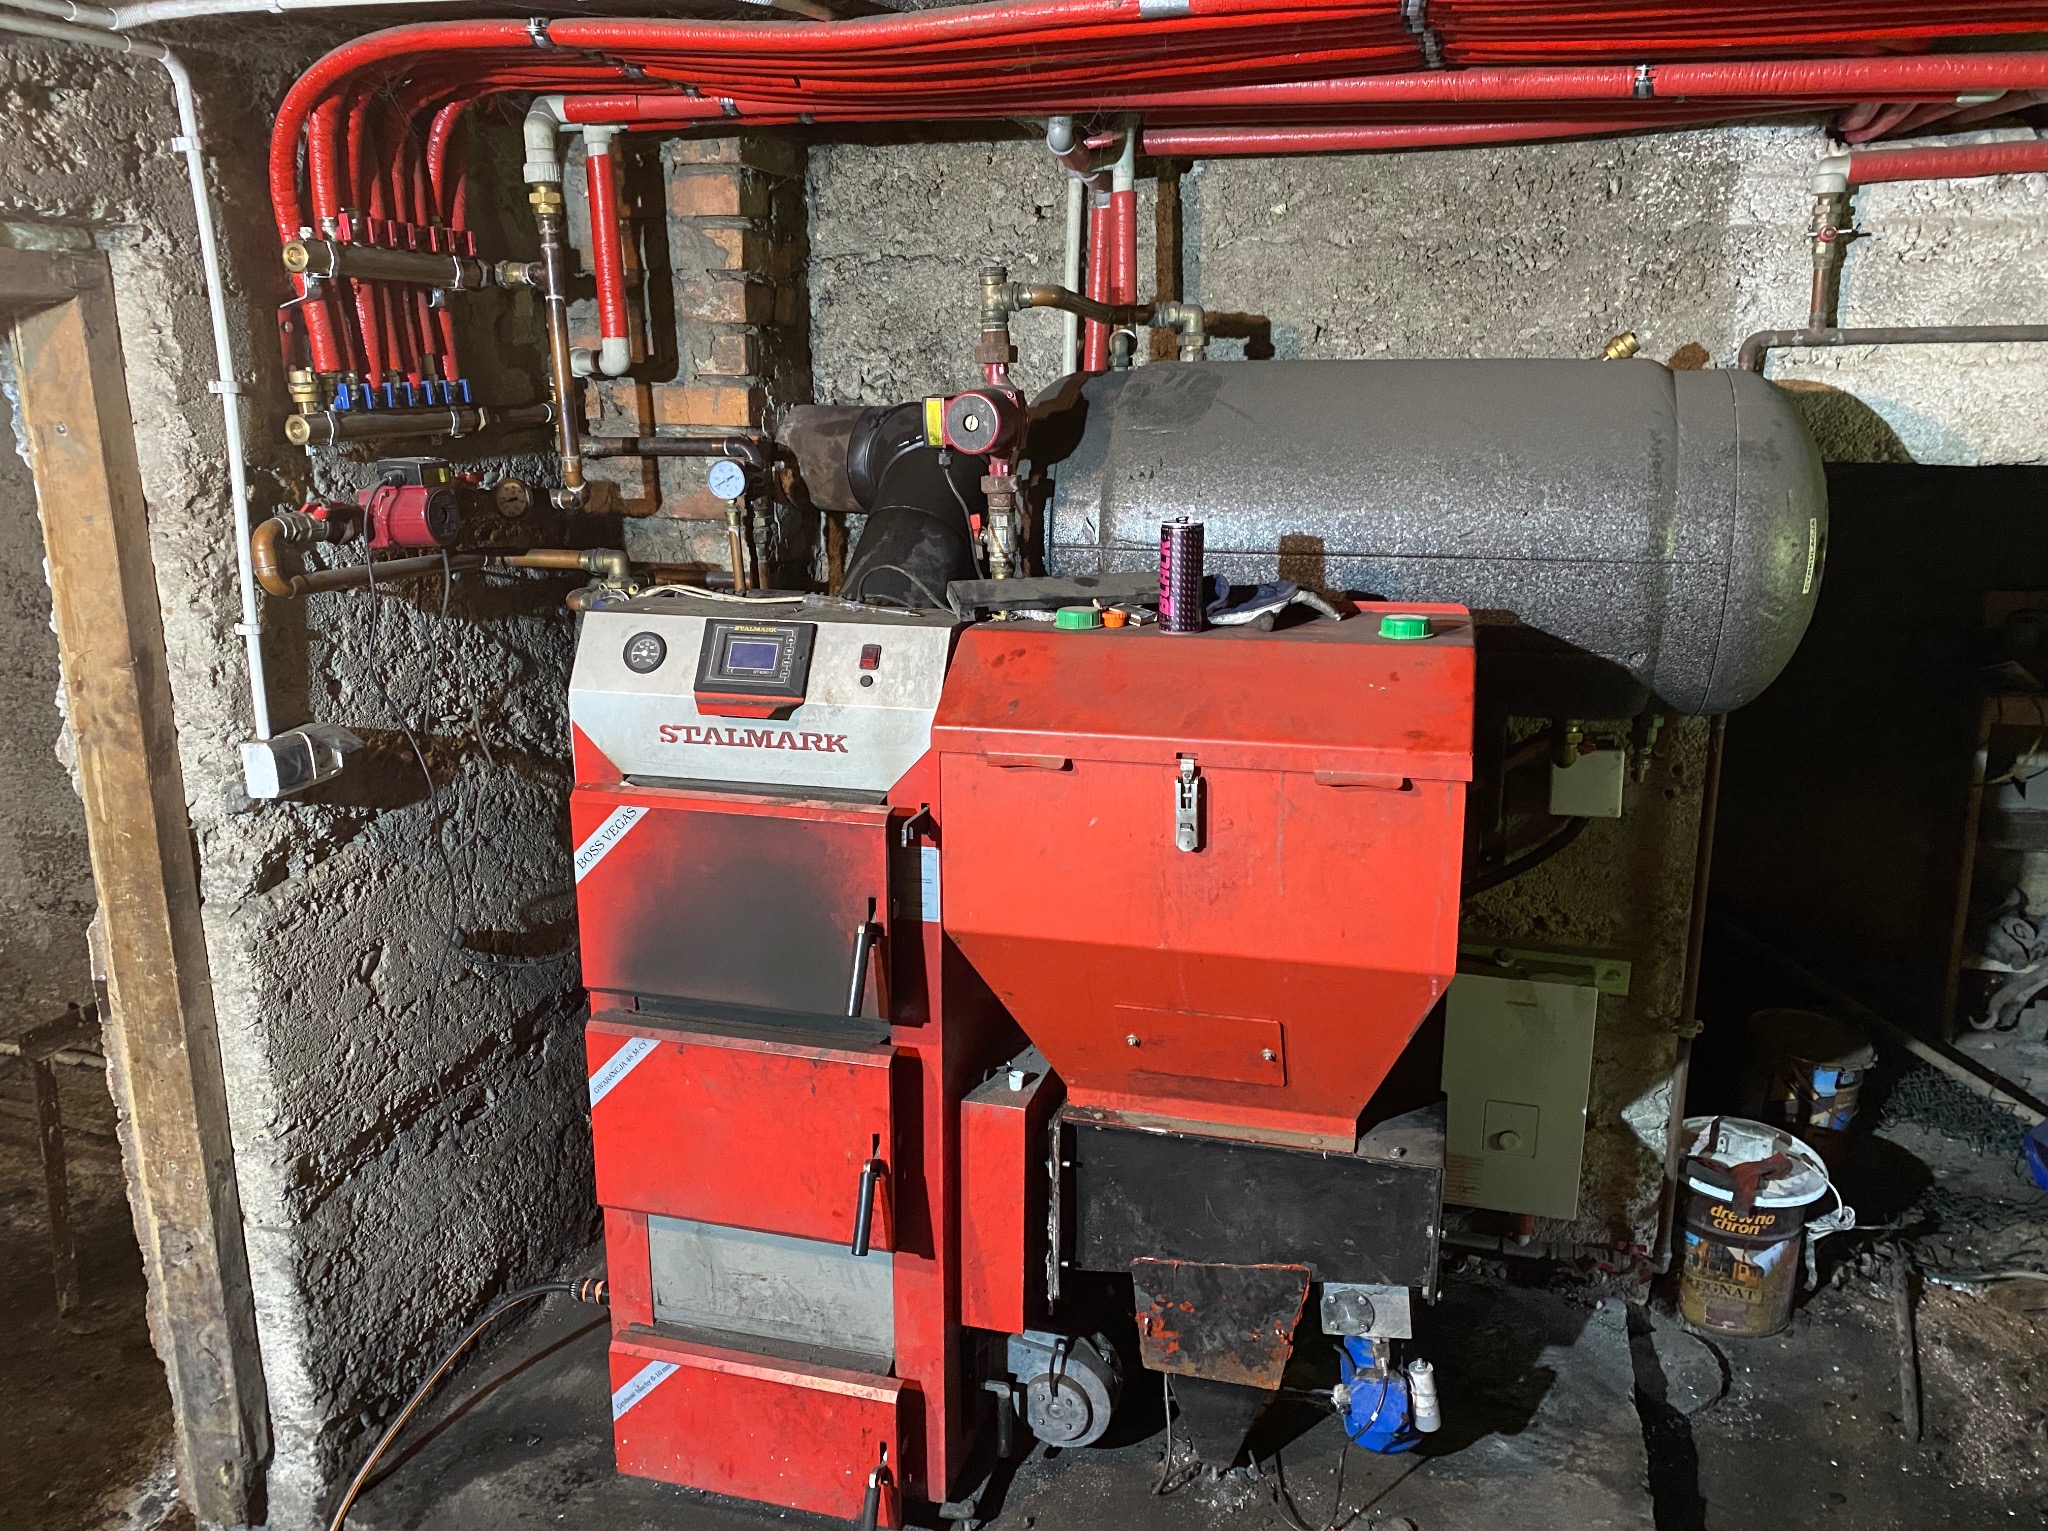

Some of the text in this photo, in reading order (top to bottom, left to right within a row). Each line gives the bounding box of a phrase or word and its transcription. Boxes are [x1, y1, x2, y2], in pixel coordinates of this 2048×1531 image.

[1805, 520, 1816, 590] CYRKULACJA
[733, 625, 778, 633] STALMARK
[659, 724, 849, 753] STALMARK
[576, 806, 637, 870] BOSS VEGAS
[593, 1060, 628, 1094] GWARANCJA
[1713, 1217, 1761, 1236] chron
